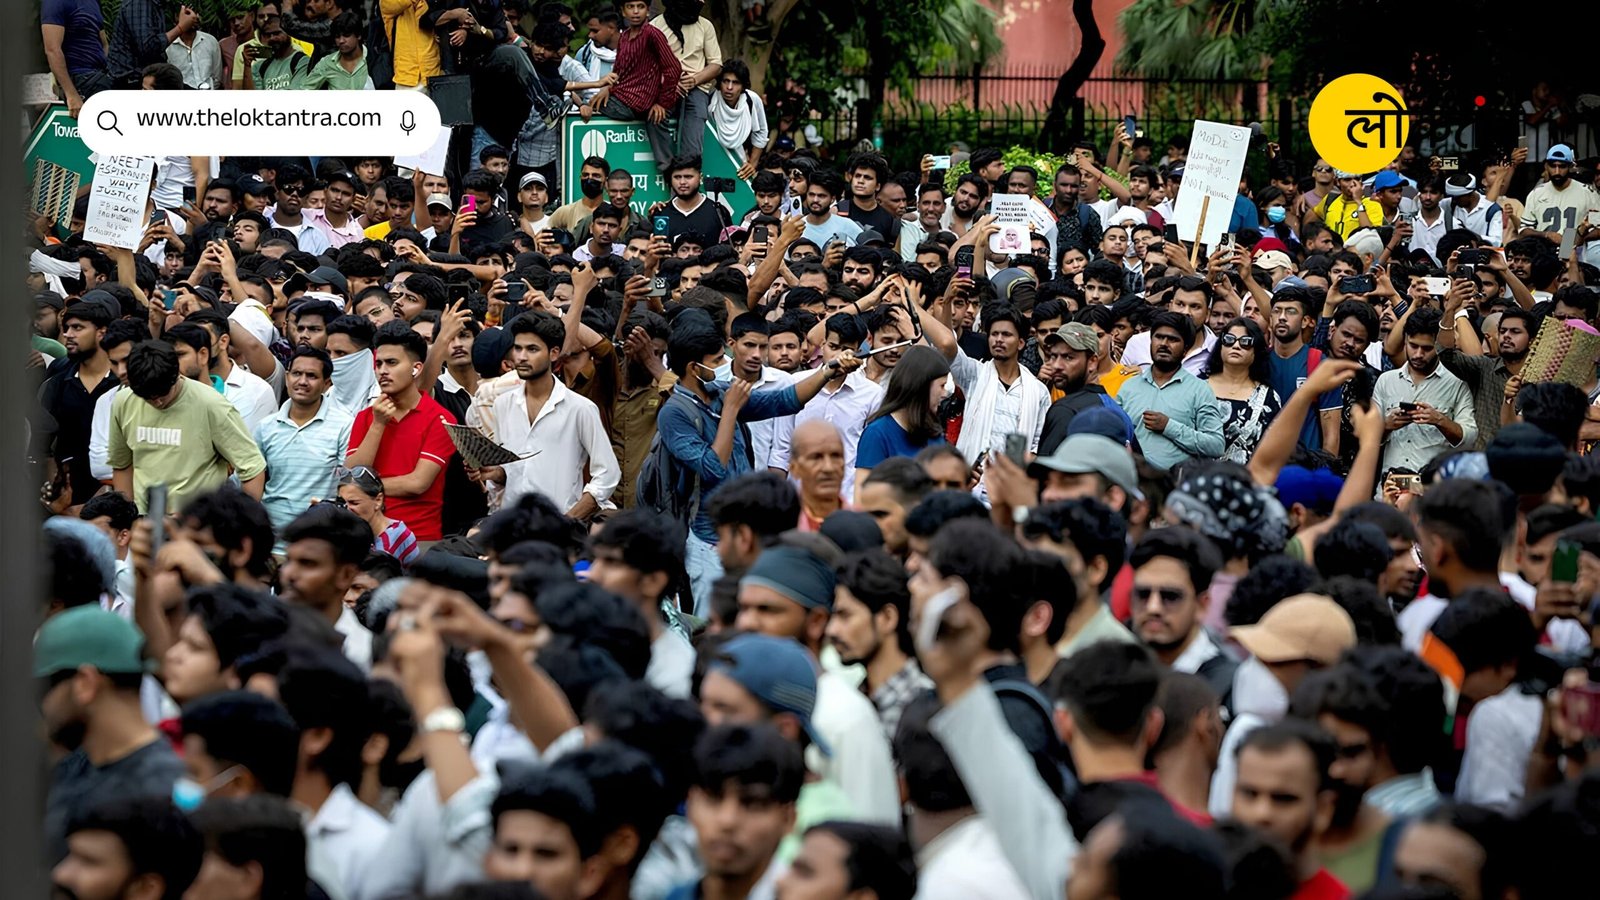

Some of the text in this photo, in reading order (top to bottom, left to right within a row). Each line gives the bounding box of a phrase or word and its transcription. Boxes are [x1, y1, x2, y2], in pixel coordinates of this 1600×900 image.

[109, 155, 145, 169] NEET
[109, 179, 142, 192] WANT
[96, 186, 141, 204] JUSTICE
[1543, 206, 1577, 232] 21
[137, 426, 182, 445] PUMA
